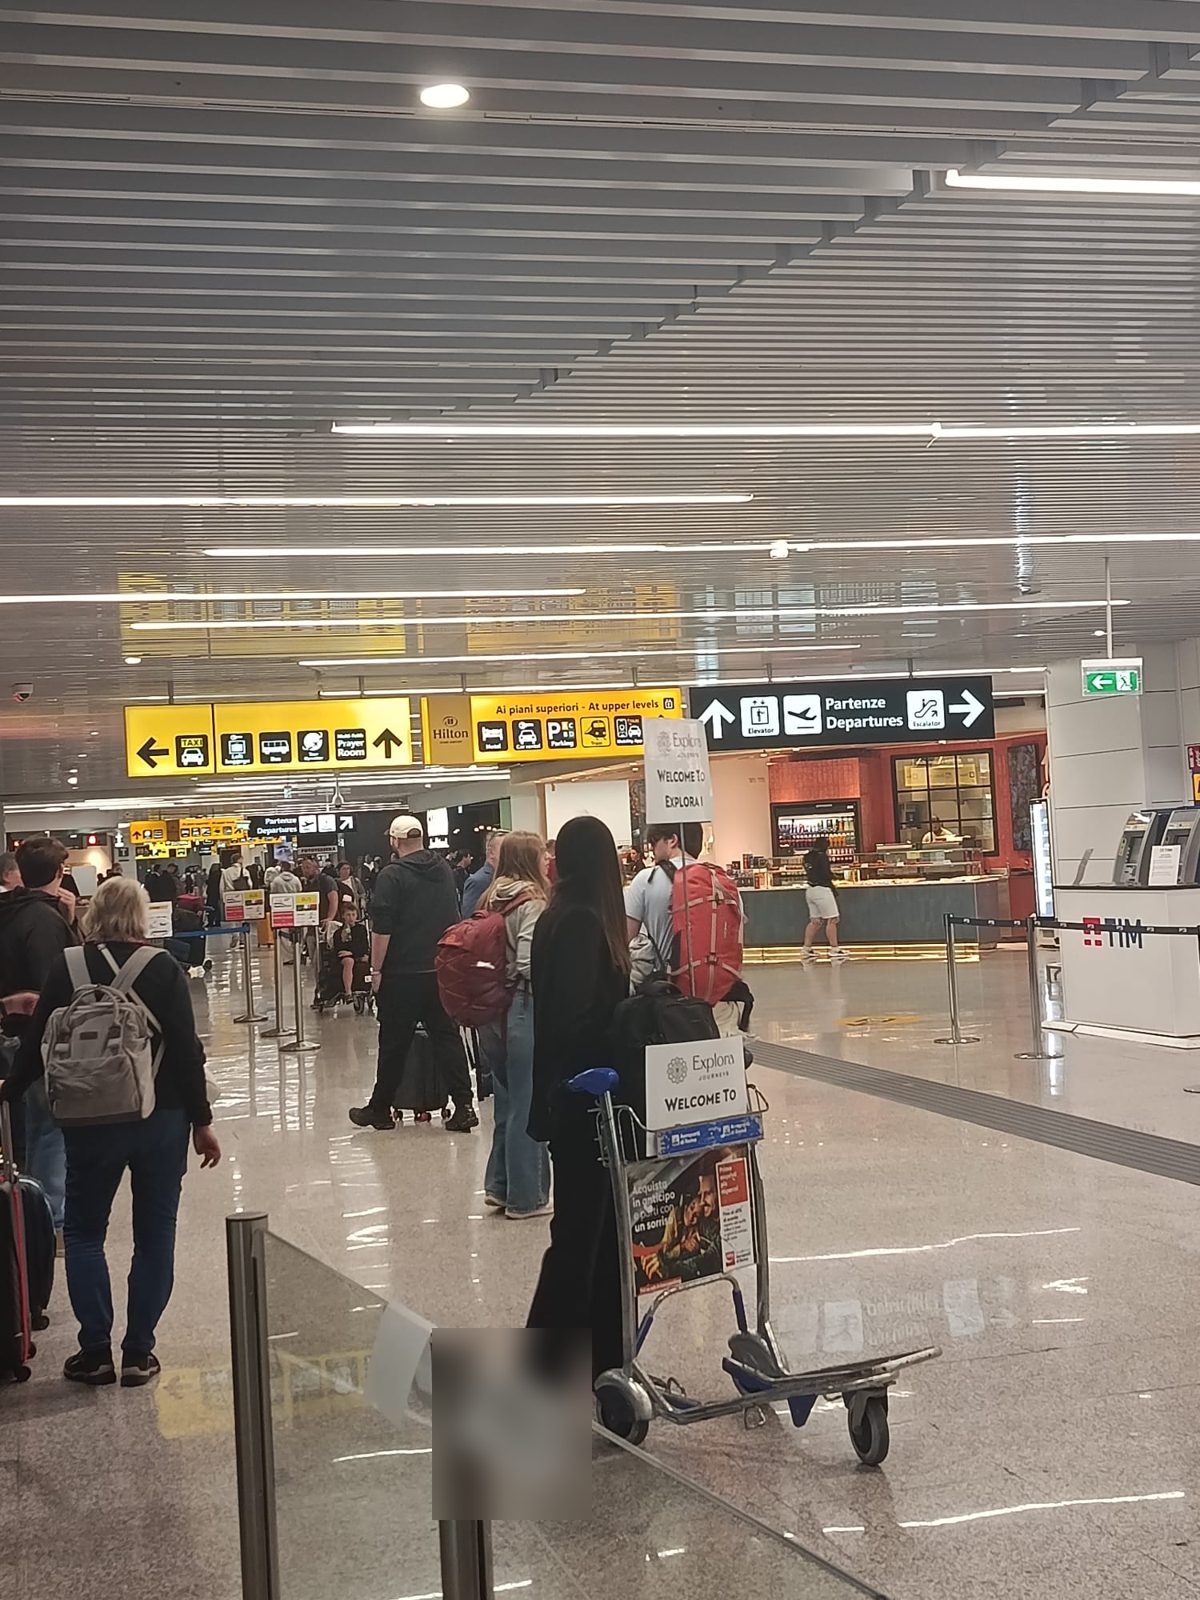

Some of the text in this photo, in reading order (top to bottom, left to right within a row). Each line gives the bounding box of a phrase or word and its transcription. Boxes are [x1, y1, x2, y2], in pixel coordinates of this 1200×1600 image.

[496, 705, 506, 714] Ai
[509, 704, 533, 716] piani
[536, 702, 579, 715] superiori
[588, 702, 600, 711] At
[602, 701, 630, 713] upper
[632, 700, 659, 710] levels
[825, 698, 886, 710] Partenze
[826, 714, 904, 731] Departures
[433, 729, 469, 739] Hilton
[548, 722, 561, 740] P
[748, 727, 774, 735] Elevator
[337, 740, 365, 749] Prayer
[551, 740, 574, 748] Parking
[338, 748, 365, 758] Room
[657, 769, 695, 783] WELCOME
[665, 795, 699, 808] EXPLORA
[257, 827, 298, 835] Departures
[1105, 918, 1142, 948] TIM
[665, 1089, 737, 1112] WELCOME TO
[632, 1180, 668, 1196] Acquista
[632, 1190, 676, 1208] in anticipo
[634, 1215, 674, 1233] un sorriso
